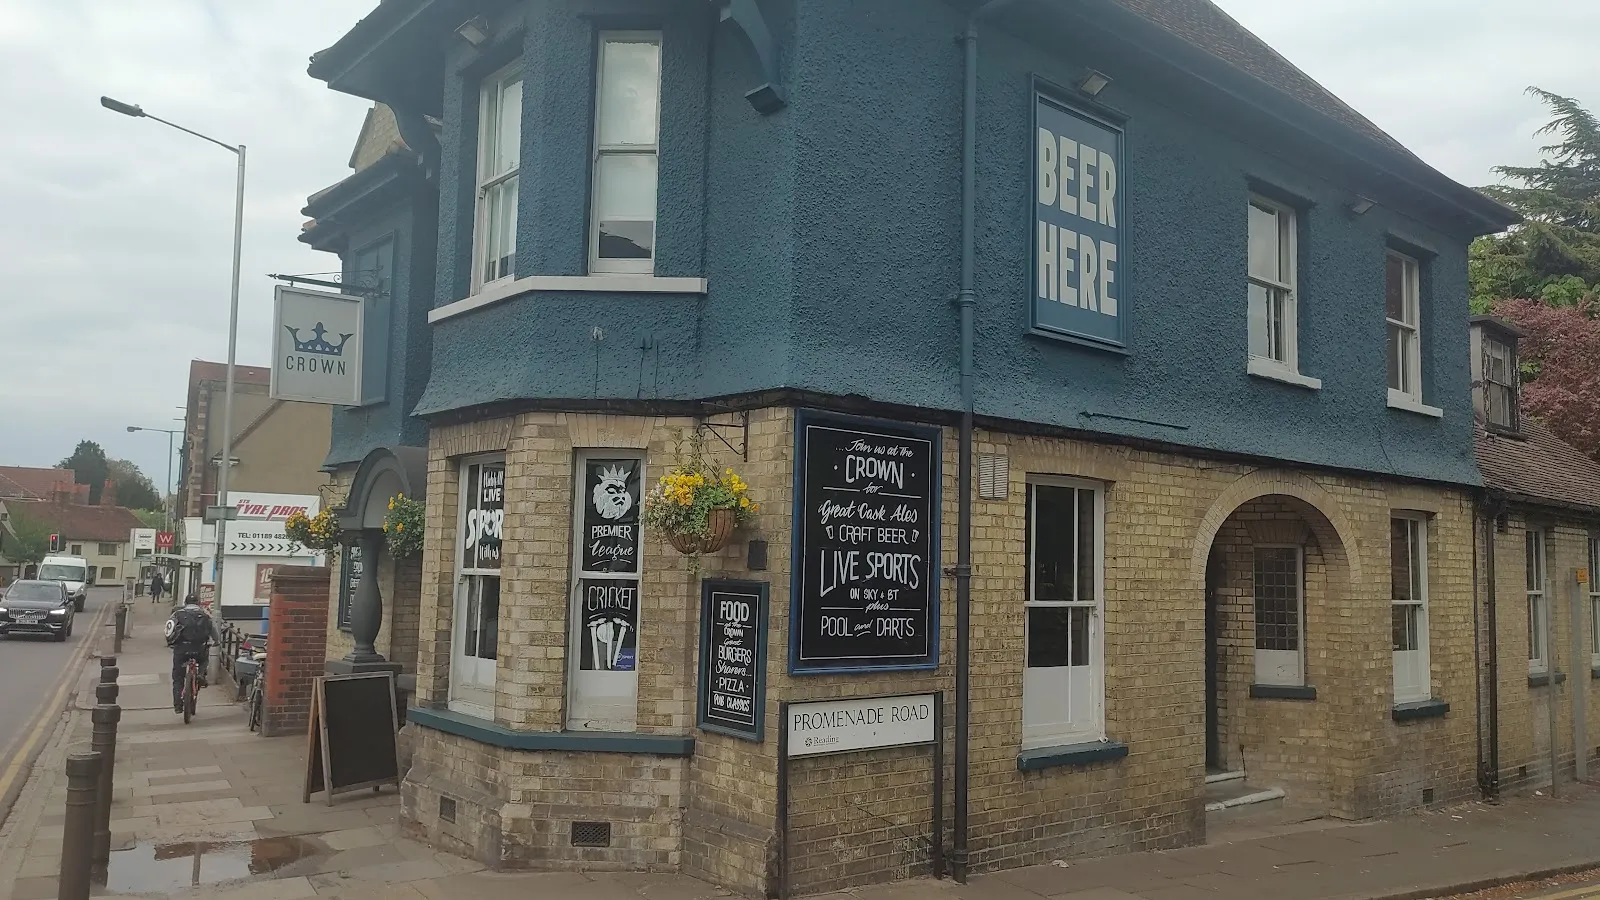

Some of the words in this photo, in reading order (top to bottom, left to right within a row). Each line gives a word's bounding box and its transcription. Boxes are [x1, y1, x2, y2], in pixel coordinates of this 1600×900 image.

[1038, 127, 1117, 229] BEER
[1038, 219, 1118, 317] HERE
[286, 355, 346, 376] CROWN
[873, 445, 886, 455] us
[886, 444, 899, 457] at
[845, 454, 904, 490] CROWN
[483, 487, 502, 503] LIVE
[862, 481, 884, 495] for
[236, 504, 271, 515] TYRE
[818, 499, 856, 525] Great
[857, 502, 886, 521] Cask
[889, 503, 918, 523] Ales
[159, 534, 173, 544] W
[591, 524, 634, 542] PREMIER
[839, 524, 875, 545] CRAFT
[877, 527, 909, 545] BEER
[820, 549, 860, 598] LIVE
[865, 551, 922, 590] SPORTS
[587, 585, 637, 612] CRICKET
[849, 587, 860, 601] ON
[863, 588, 879, 601] SKY
[887, 588, 900, 601] BT
[719, 600, 750, 624] FOOD
[865, 600, 890, 614] plus
[723, 627, 744, 639] CROWN
[820, 615, 853, 637] POOL
[853, 619, 874, 633] and
[876, 617, 915, 640] DARTS
[718, 644, 752, 666] BURGERS
[718, 676, 745, 693] PIZZA
[713, 693, 725, 707] PUB
[726, 696, 750, 712] CLASSICS
[793, 707, 885, 732] PROMENADE
[890, 704, 930, 723] ROAD
